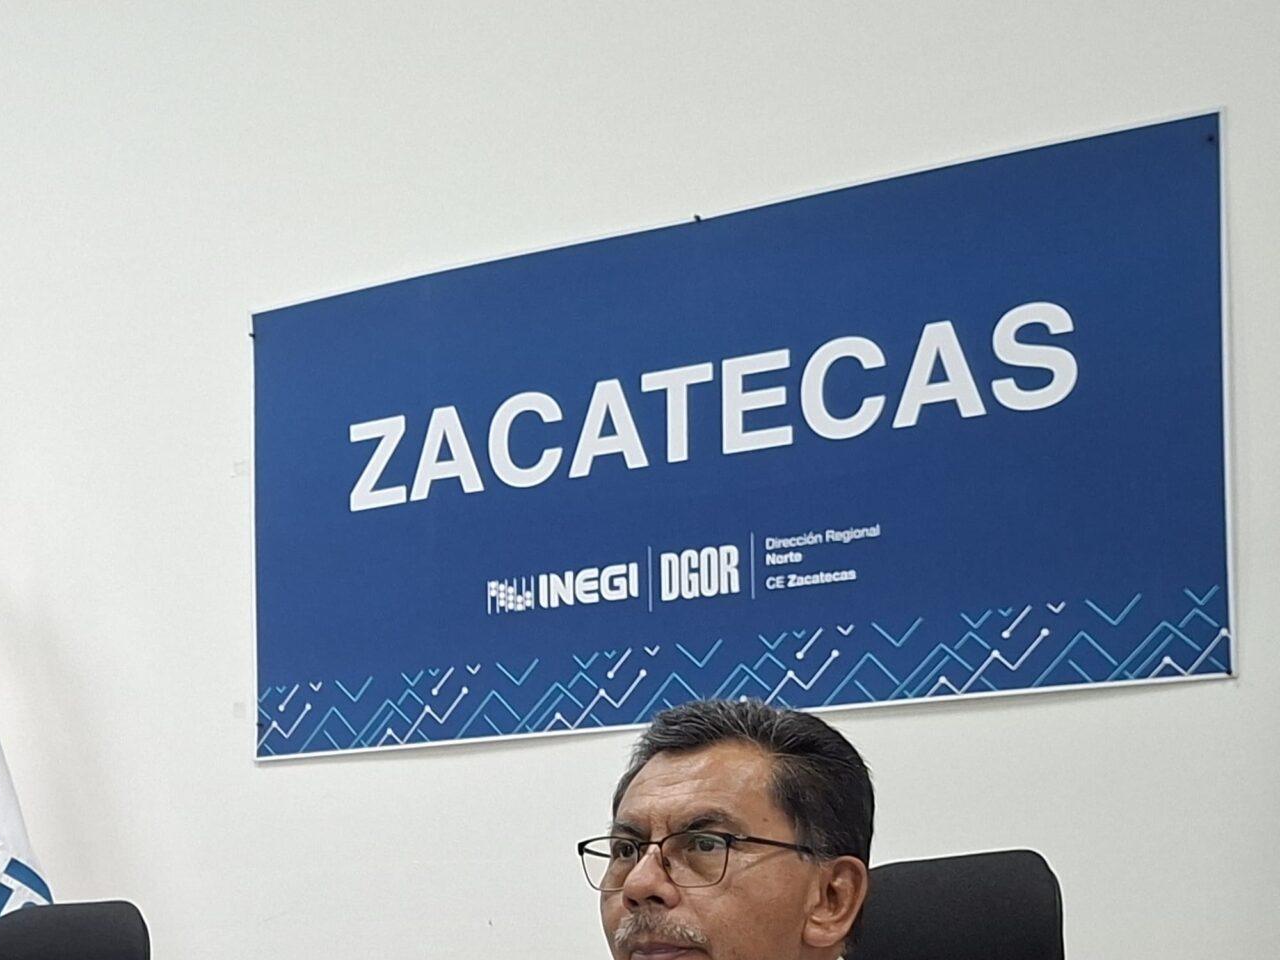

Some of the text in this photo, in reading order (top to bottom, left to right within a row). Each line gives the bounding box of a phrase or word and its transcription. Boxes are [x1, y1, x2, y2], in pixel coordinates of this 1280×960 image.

[349, 301, 1077, 513] ZACATECAS
[765, 523, 880, 551] Dirección Regional
[661, 544, 740, 601] DGOR
[765, 551, 802, 566] Norte
[539, 562, 639, 609] INEGI
[765, 569, 857, 590] CE Zacatecas
